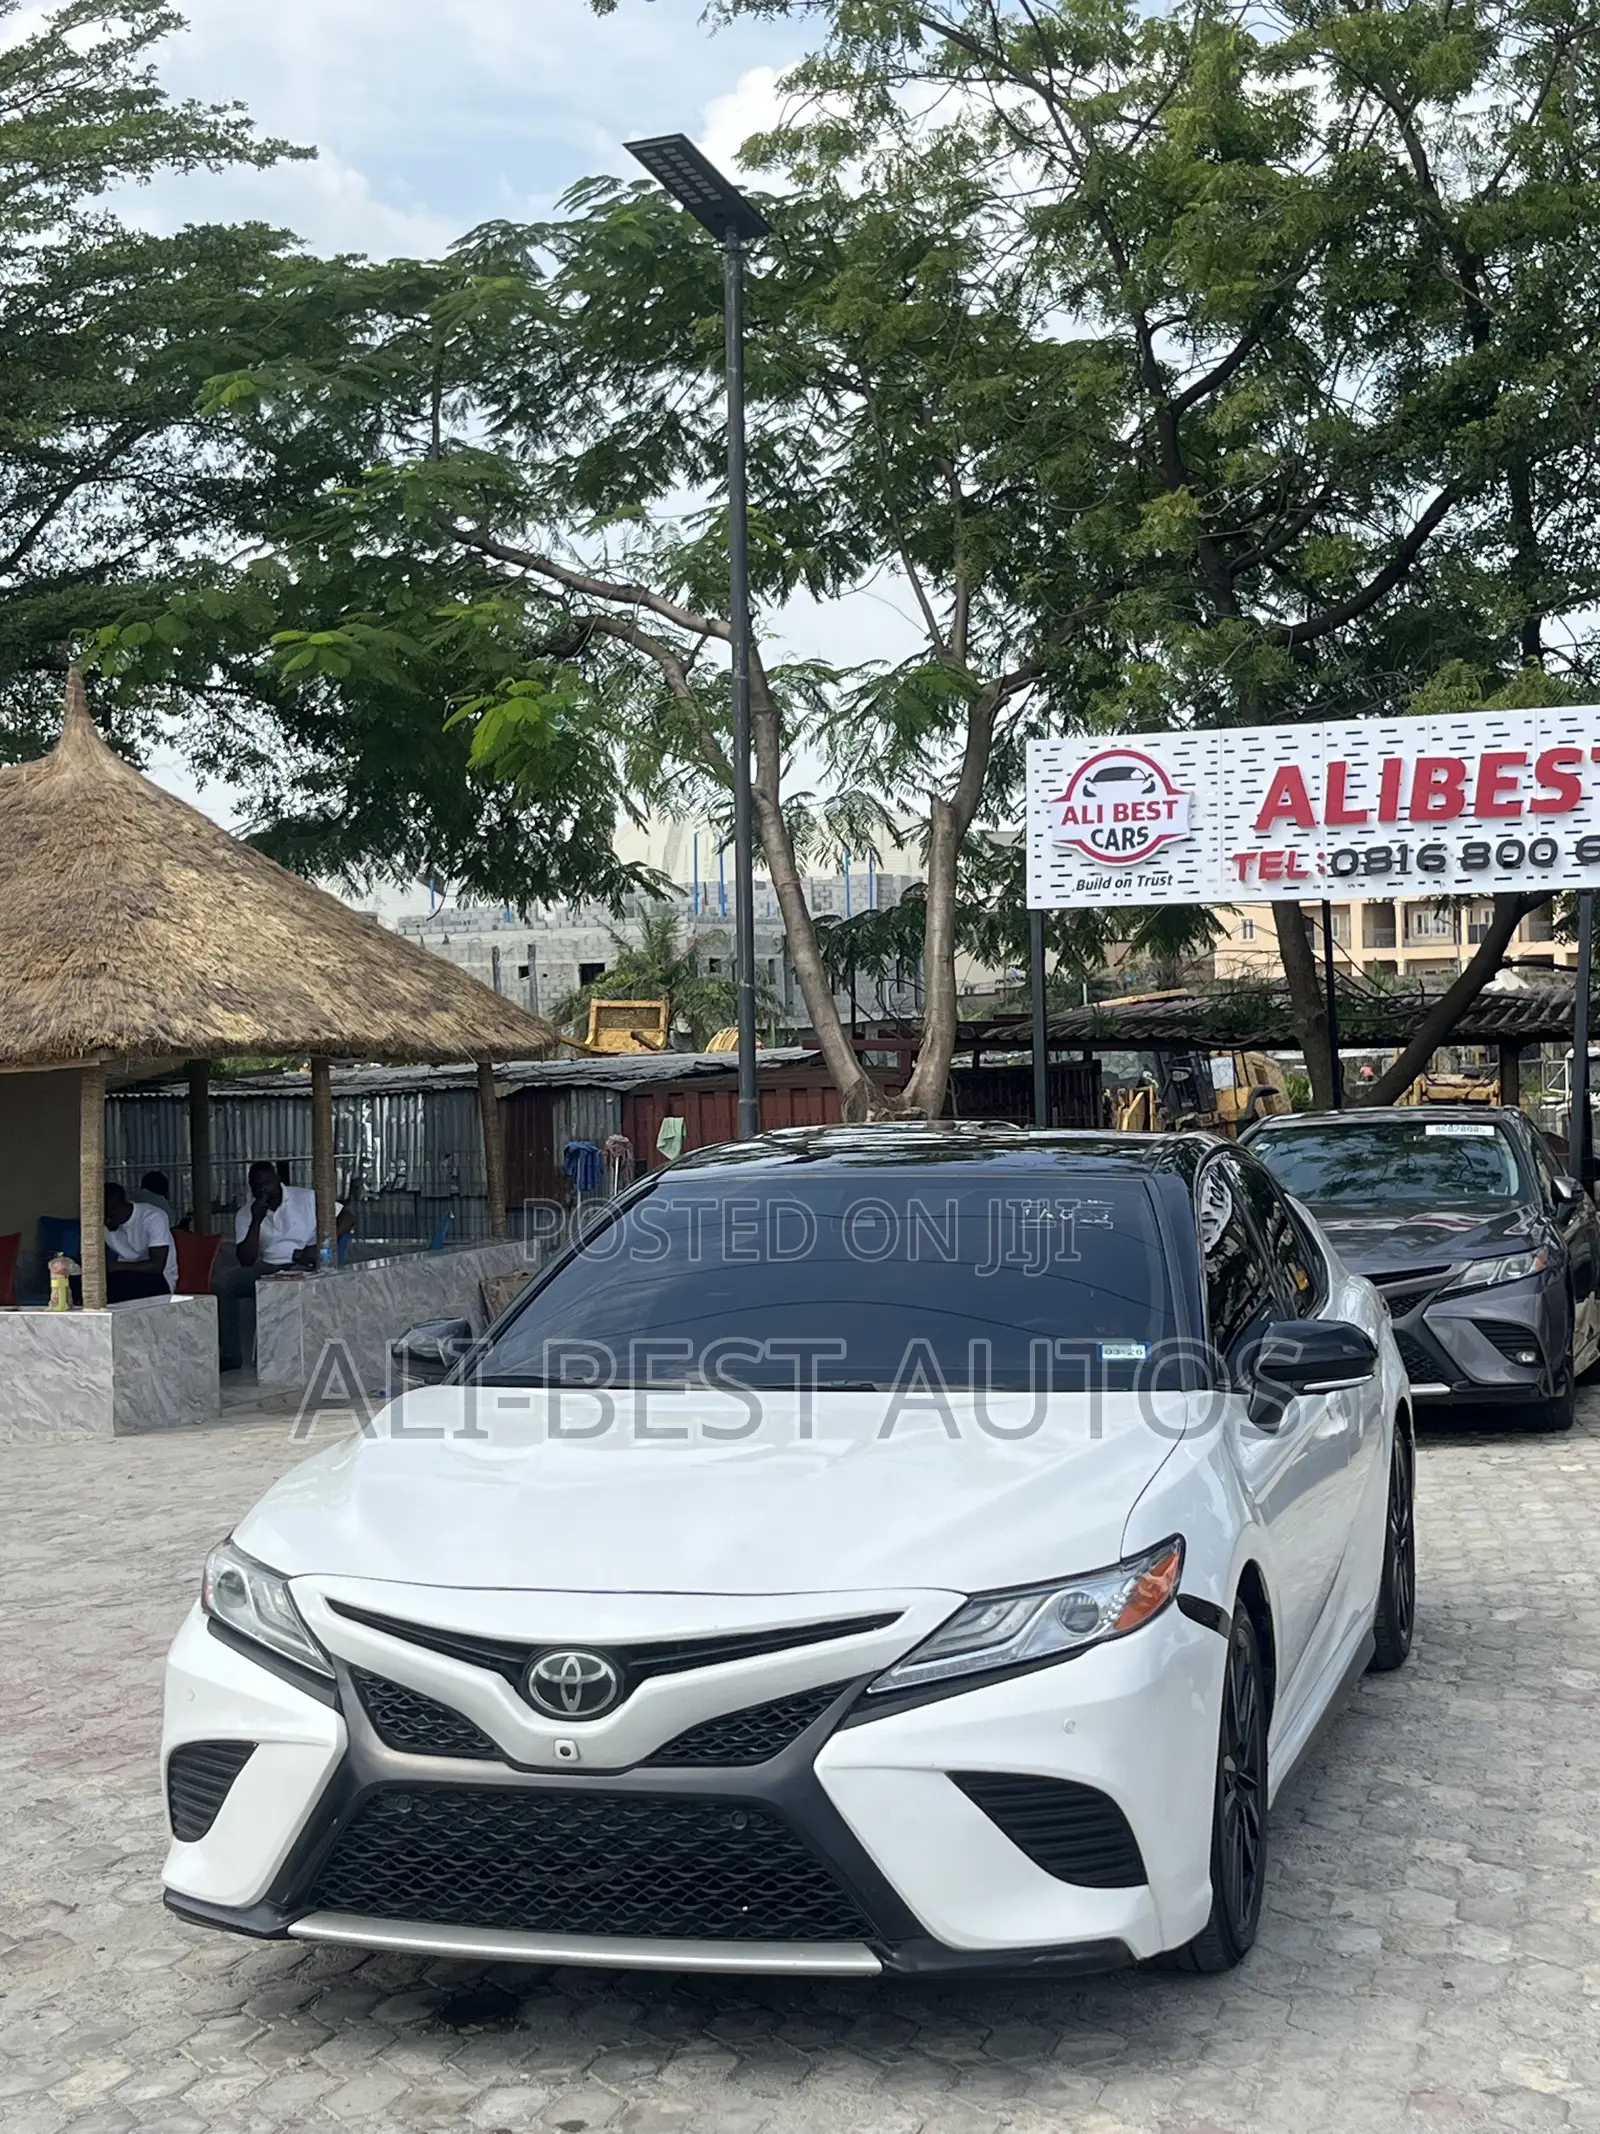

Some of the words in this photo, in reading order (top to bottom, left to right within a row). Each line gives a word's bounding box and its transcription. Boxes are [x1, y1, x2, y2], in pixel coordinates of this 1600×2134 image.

[1253, 746, 1600, 831] ALIBES
[1061, 804, 1103, 826] ALI
[1112, 799, 1178, 823] BEST
[1090, 825, 1149, 851] CARS
[1460, 836, 1558, 873] 800
[1075, 876, 1112, 892] Build
[1114, 878, 1133, 889] on
[1137, 874, 1174, 888] Trust
